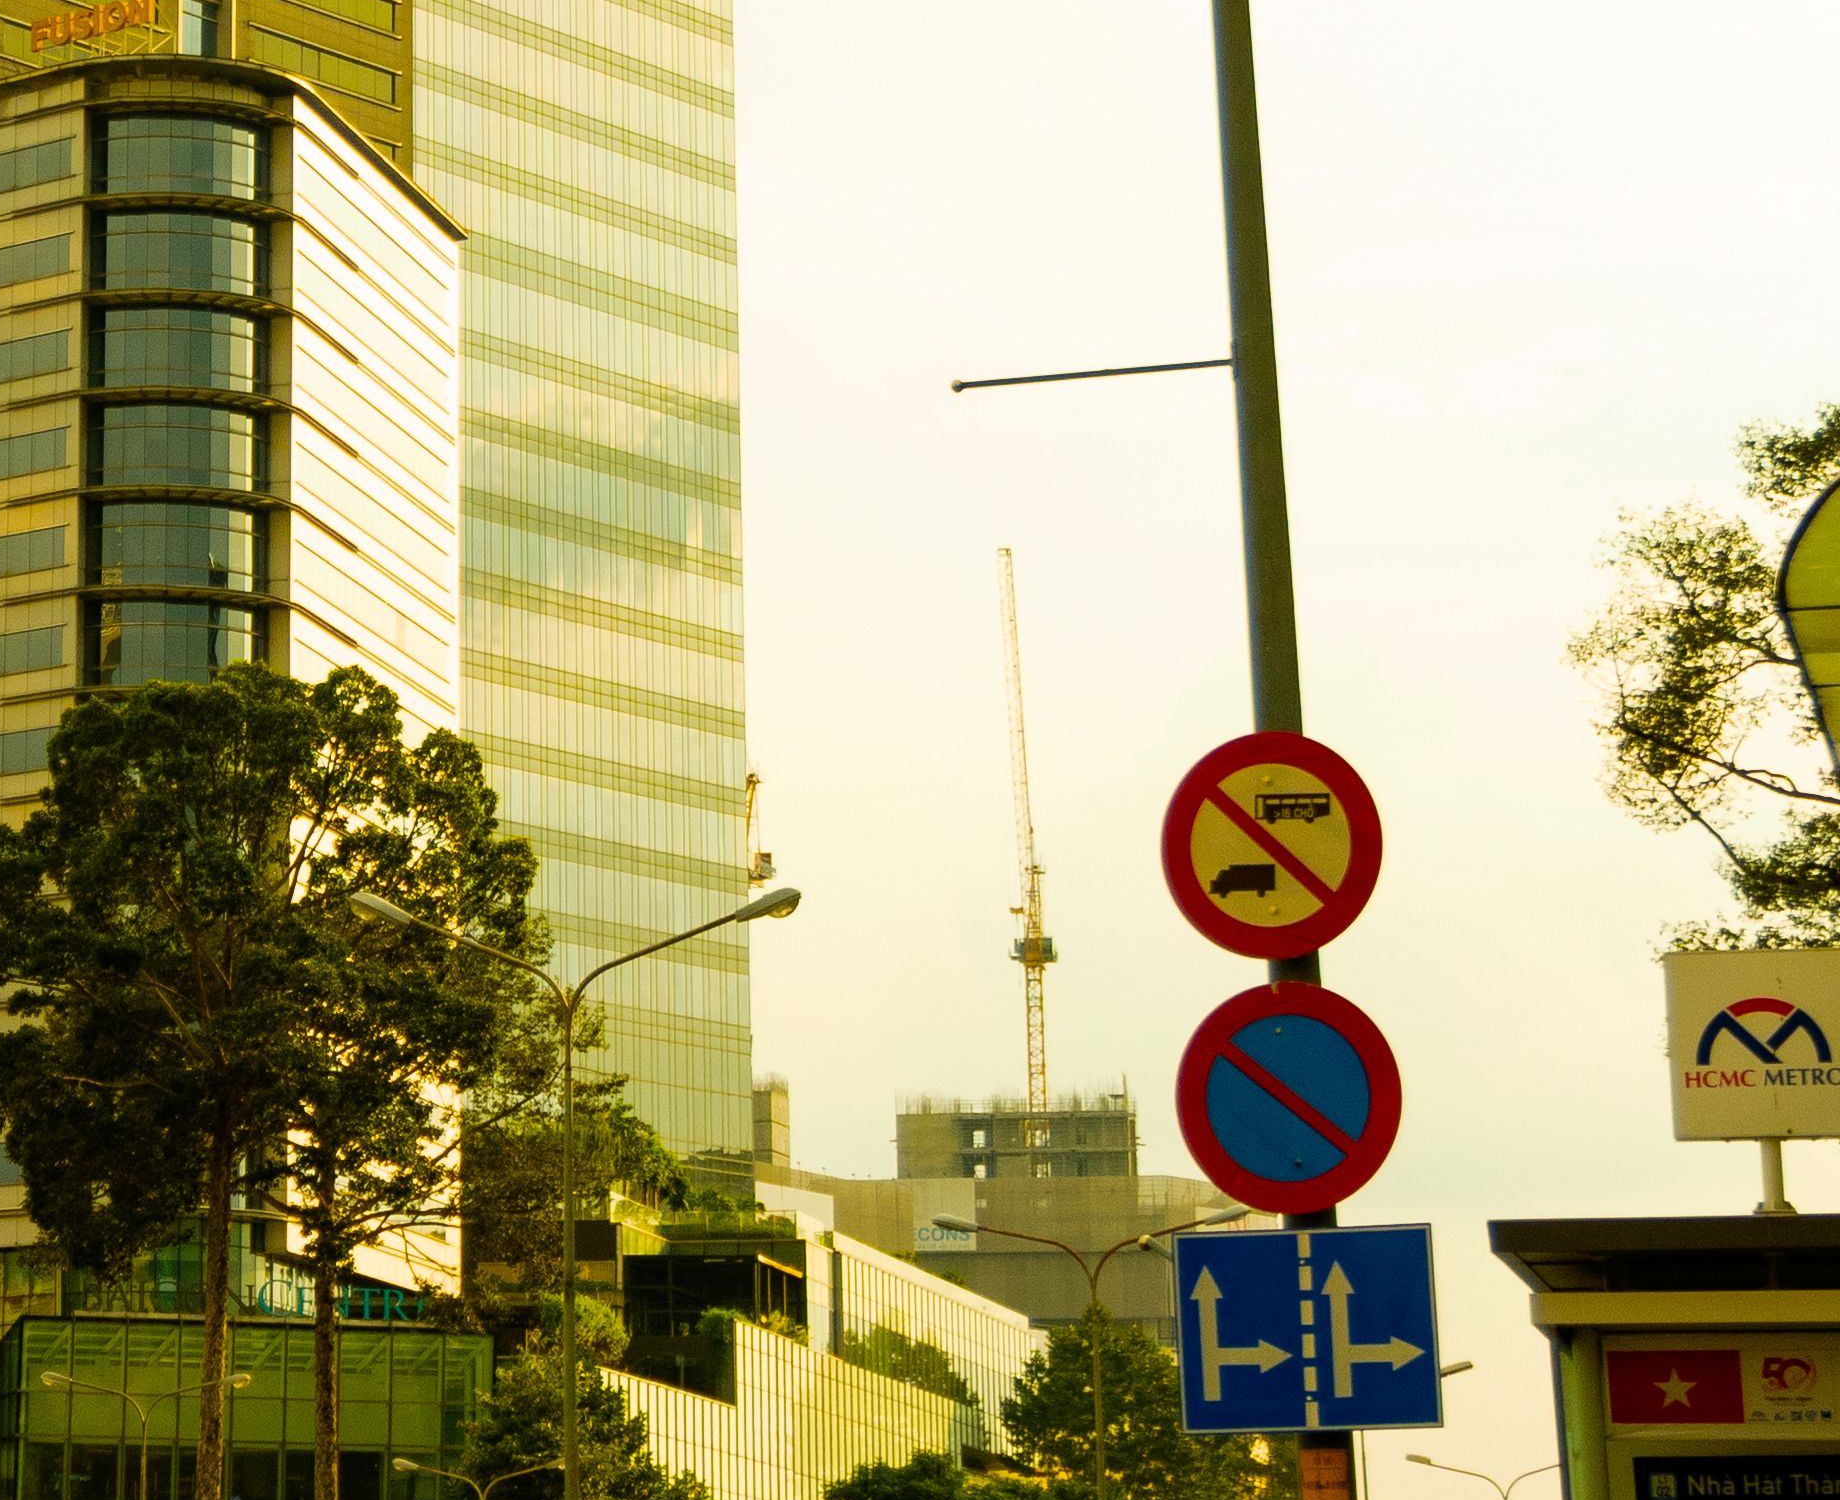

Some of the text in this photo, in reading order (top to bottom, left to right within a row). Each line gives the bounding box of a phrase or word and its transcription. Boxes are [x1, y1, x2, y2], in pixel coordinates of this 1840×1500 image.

[1684, 1067, 1840, 1089] HCMC METRO
[1686, 1474, 1737, 1496] Nhà
[1744, 1474, 1783, 1496] Hát
